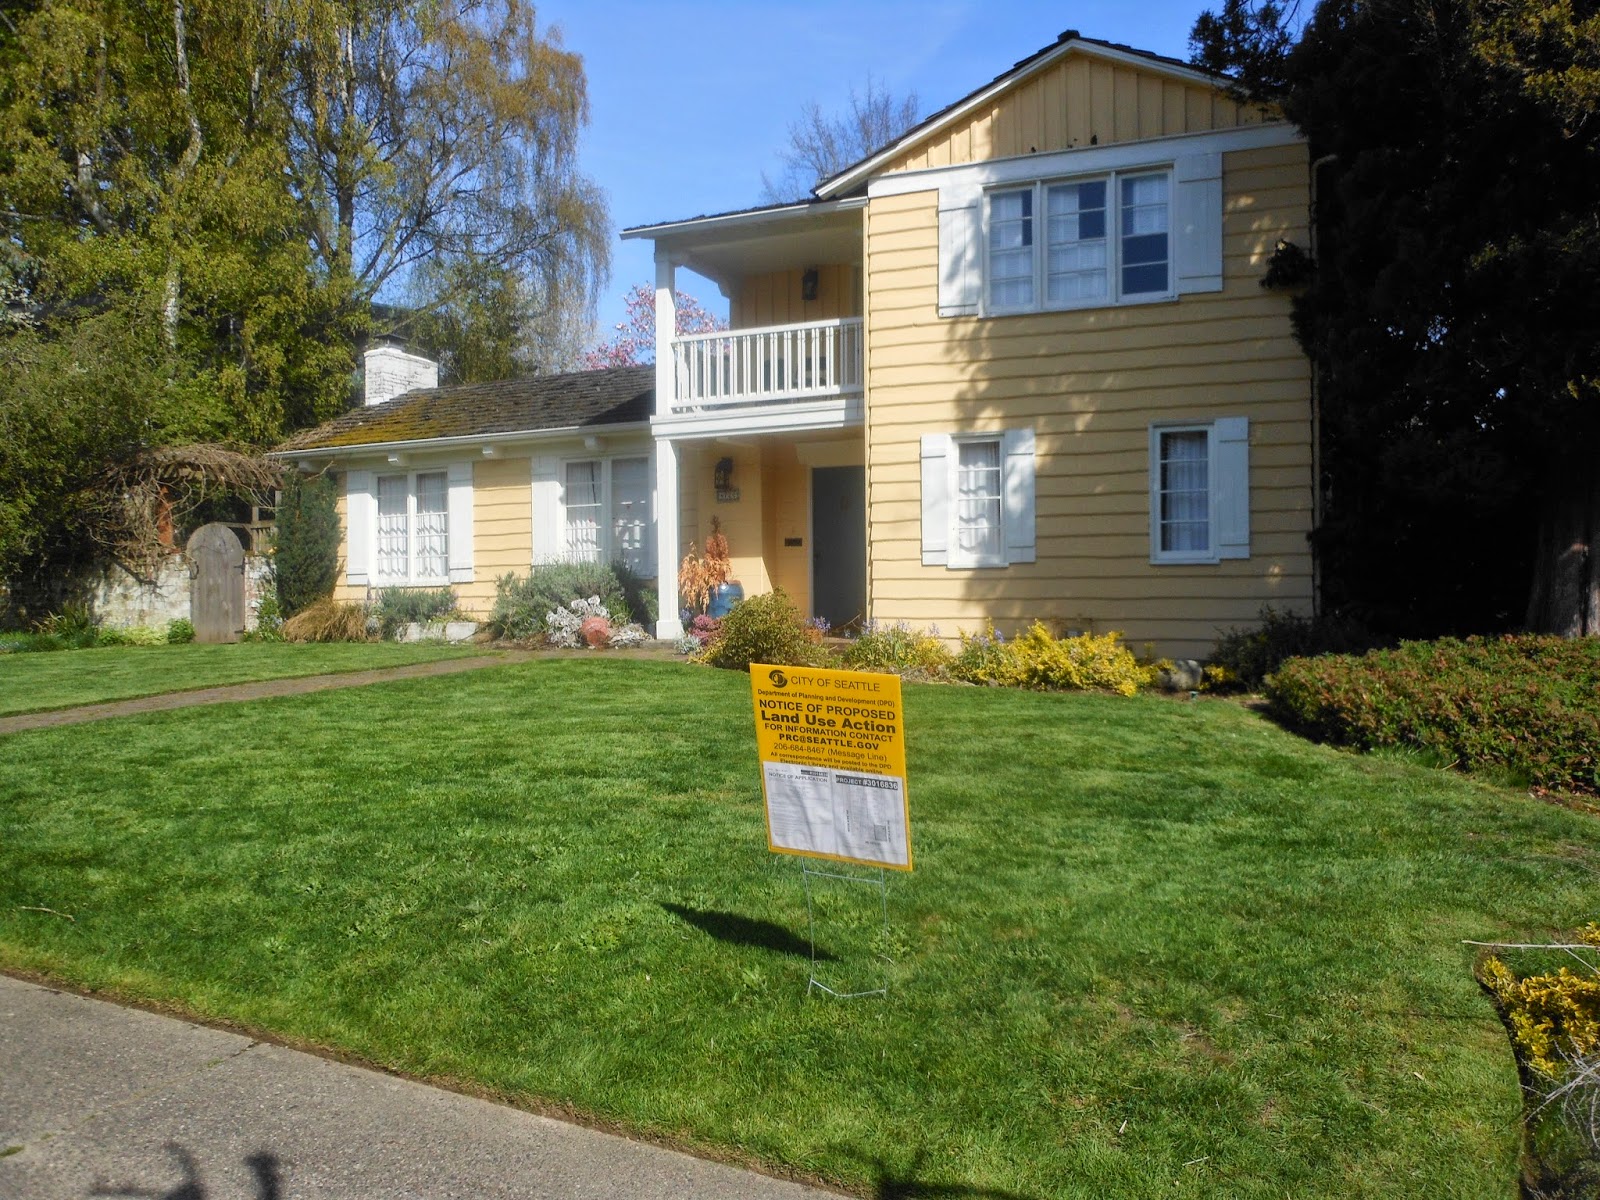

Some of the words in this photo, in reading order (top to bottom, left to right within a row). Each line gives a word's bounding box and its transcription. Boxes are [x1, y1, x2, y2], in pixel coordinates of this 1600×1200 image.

[791, 676, 813, 686] CITY
[817, 678, 831, 687] OF
[834, 680, 880, 692] SEATTLE
[758, 689, 790, 697] Department
[799, 693, 824, 701] Planning
[837, 696, 876, 705] Development
[877, 700, 895, 708] (DPD)
[759, 699, 803, 711] NOTICE
[807, 703, 822, 713] OF
[827, 706, 895, 720] PROPOSED
[761, 710, 800, 724] Land
[805, 714, 836, 727] Use
[842, 718, 896, 734] Action
[765, 723, 783, 731] FOR
[785, 725, 846, 738] INFORMATION
[849, 732, 893, 742] CONTACT
[779, 733, 879, 751] PRC@SEATTLE.GOV
[774, 743, 826, 755] 206-684-8467
[828, 749, 866, 760] (Message
[867, 753, 888, 762] Line)
[779, 753, 823, 762] correspondence
[836, 777, 861, 785] PROJECT
